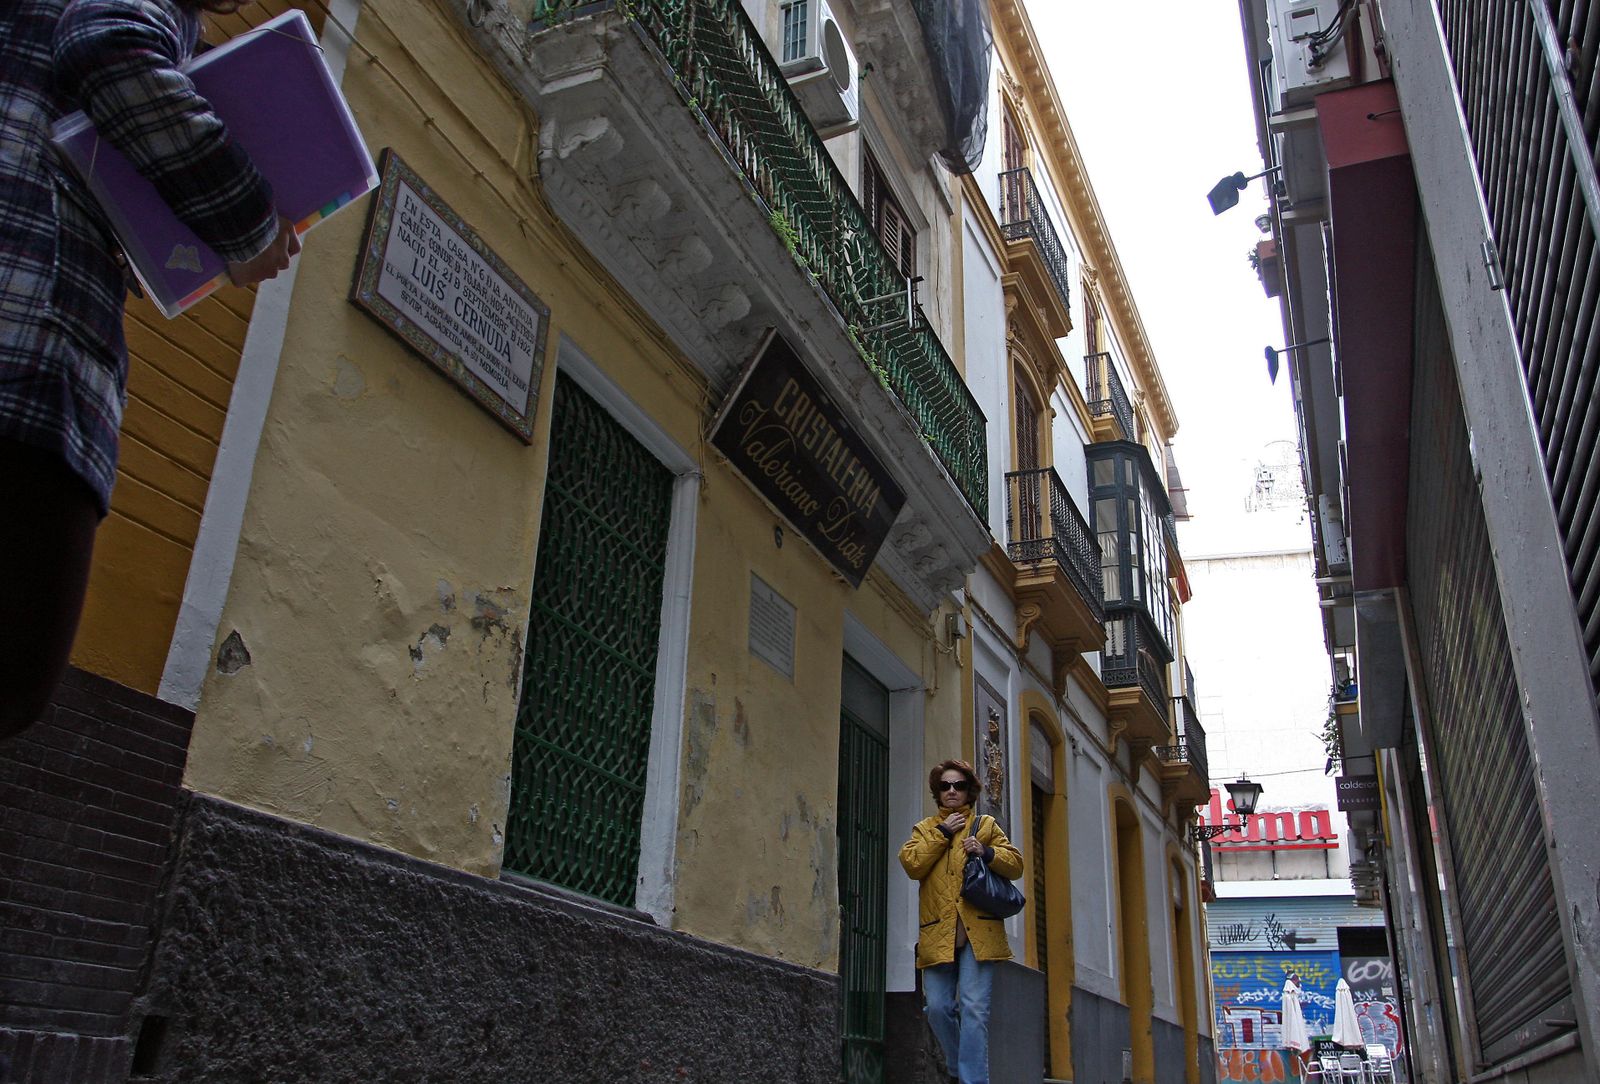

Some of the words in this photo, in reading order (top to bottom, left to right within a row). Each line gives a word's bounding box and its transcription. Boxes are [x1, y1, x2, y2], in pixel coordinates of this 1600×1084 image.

[385, 262, 395, 277] EL
[395, 271, 418, 298] POETA
[400, 211, 427, 243] CALLE
[428, 237, 455, 269] CONDE
[489, 295, 505, 316] HOY
[404, 194, 418, 217] EN
[419, 212, 442, 242] ESTA
[447, 238, 469, 267] CASA
[501, 293, 533, 330] ANTIGUA
[411, 257, 447, 301] LUIS
[454, 296, 512, 365] CERNUDA
[427, 253, 440, 273] EL
[441, 267, 454, 284] 21
[462, 285, 509, 336] SEPTIEMBRE
[516, 336, 531, 357] 1902
[423, 311, 463, 350] AGRADECIDA
[479, 358, 509, 391] MEMORIA
[739, 400, 819, 517] Valeriano
[774, 378, 880, 519] CRISTALERIA
[774, 525, 784, 549] 6
